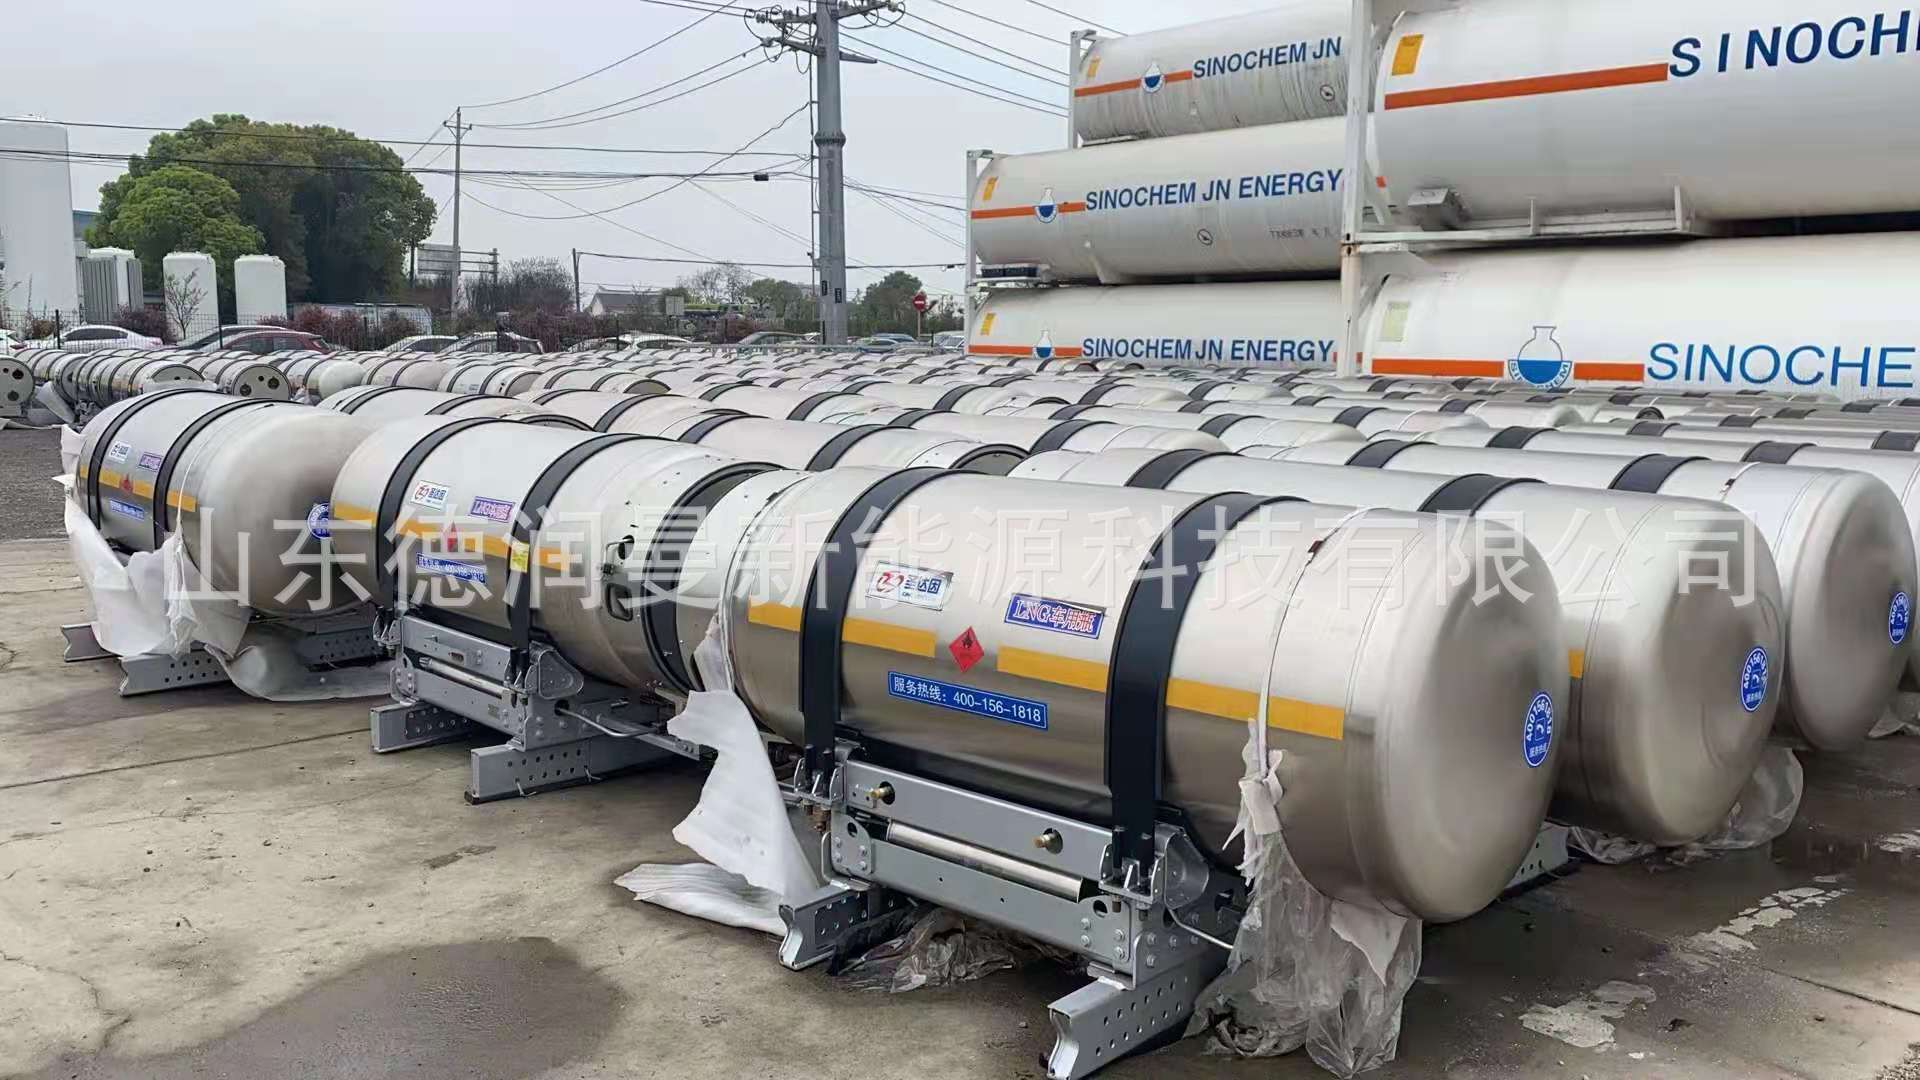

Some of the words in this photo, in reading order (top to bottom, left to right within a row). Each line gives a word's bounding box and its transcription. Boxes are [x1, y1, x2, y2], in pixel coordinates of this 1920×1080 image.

[1193, 42, 1307, 78] SINOCHEM
[1312, 36, 1342, 60] JN
[1668, 10, 1920, 78] SINOCH
[1086, 182, 1196, 210] SINOCHEM
[1202, 178, 1231, 201] JN
[1238, 168, 1343, 198] ENERGY
[1082, 337, 1192, 358] SINOCHEM
[1195, 339, 1224, 361] JN
[1231, 339, 1334, 362] ENERGY
[1647, 342, 1916, 388] SINOCHE
[953, 691, 1041, 721] 400-156-1818
